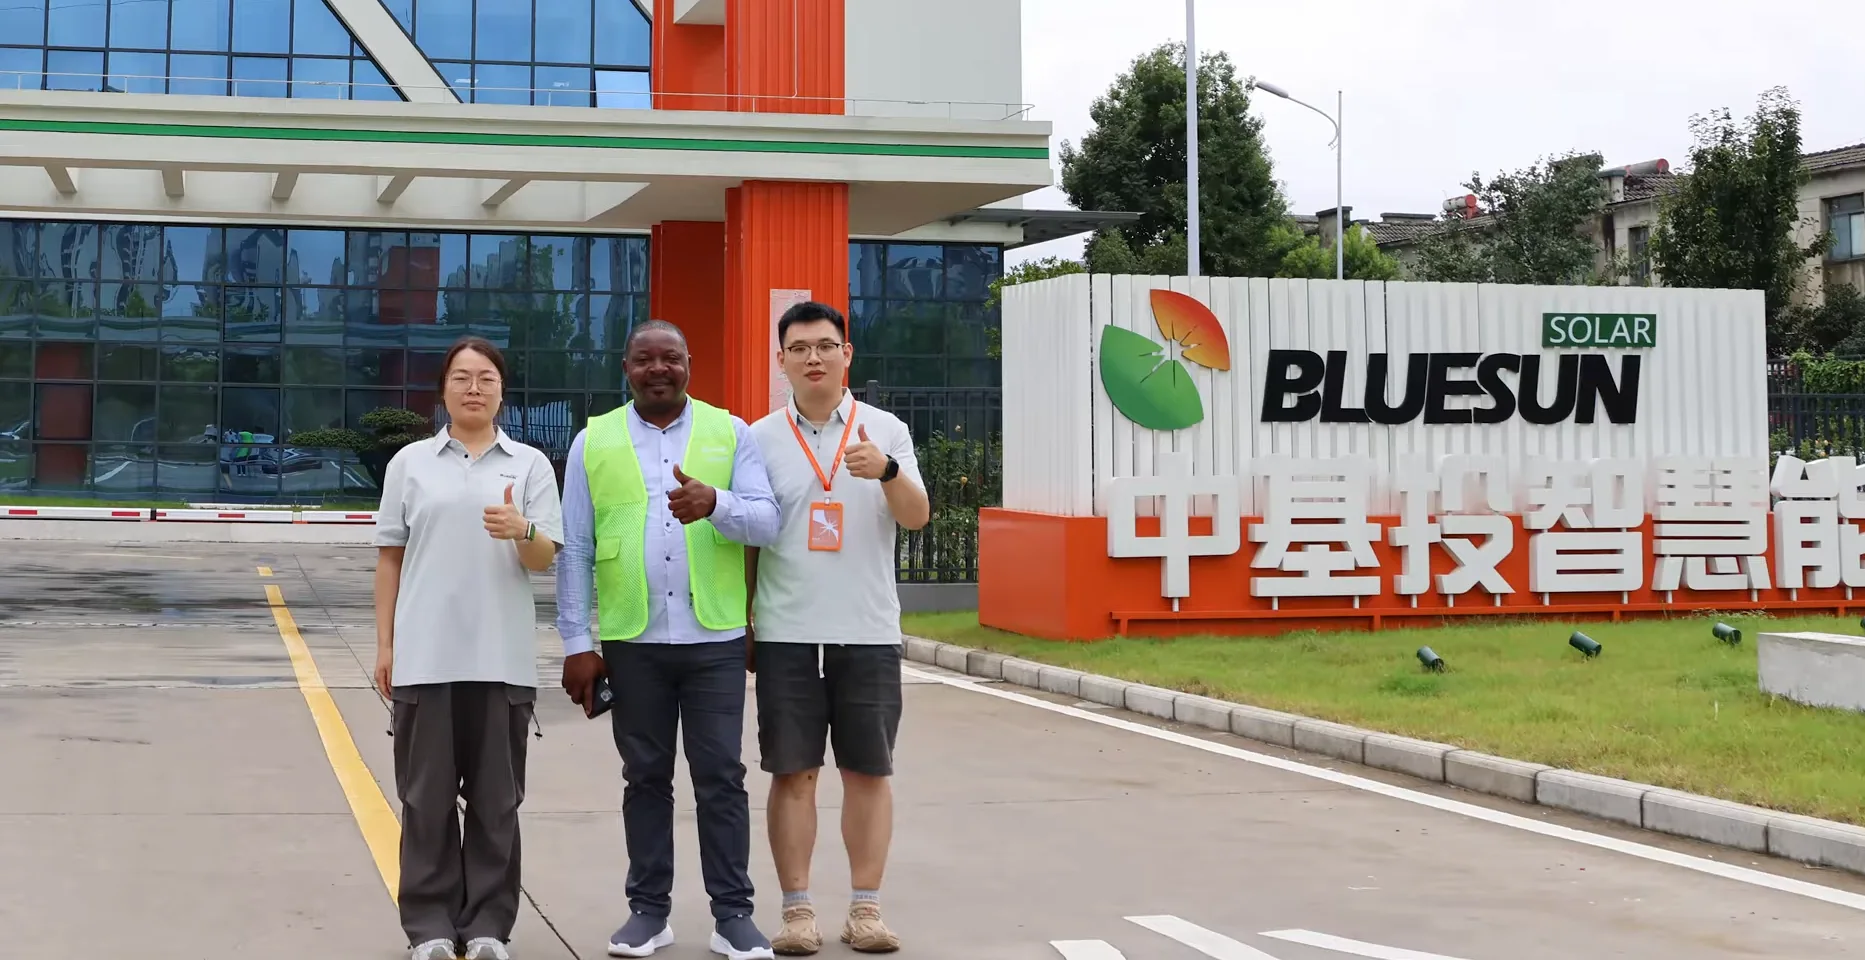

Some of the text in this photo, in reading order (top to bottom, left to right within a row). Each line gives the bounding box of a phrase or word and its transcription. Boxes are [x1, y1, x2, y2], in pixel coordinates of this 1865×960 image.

[1549, 316, 1652, 344] SOLAR
[1261, 349, 1641, 425] BLUESUN
[1107, 452, 1865, 598] 中基投智慧能
